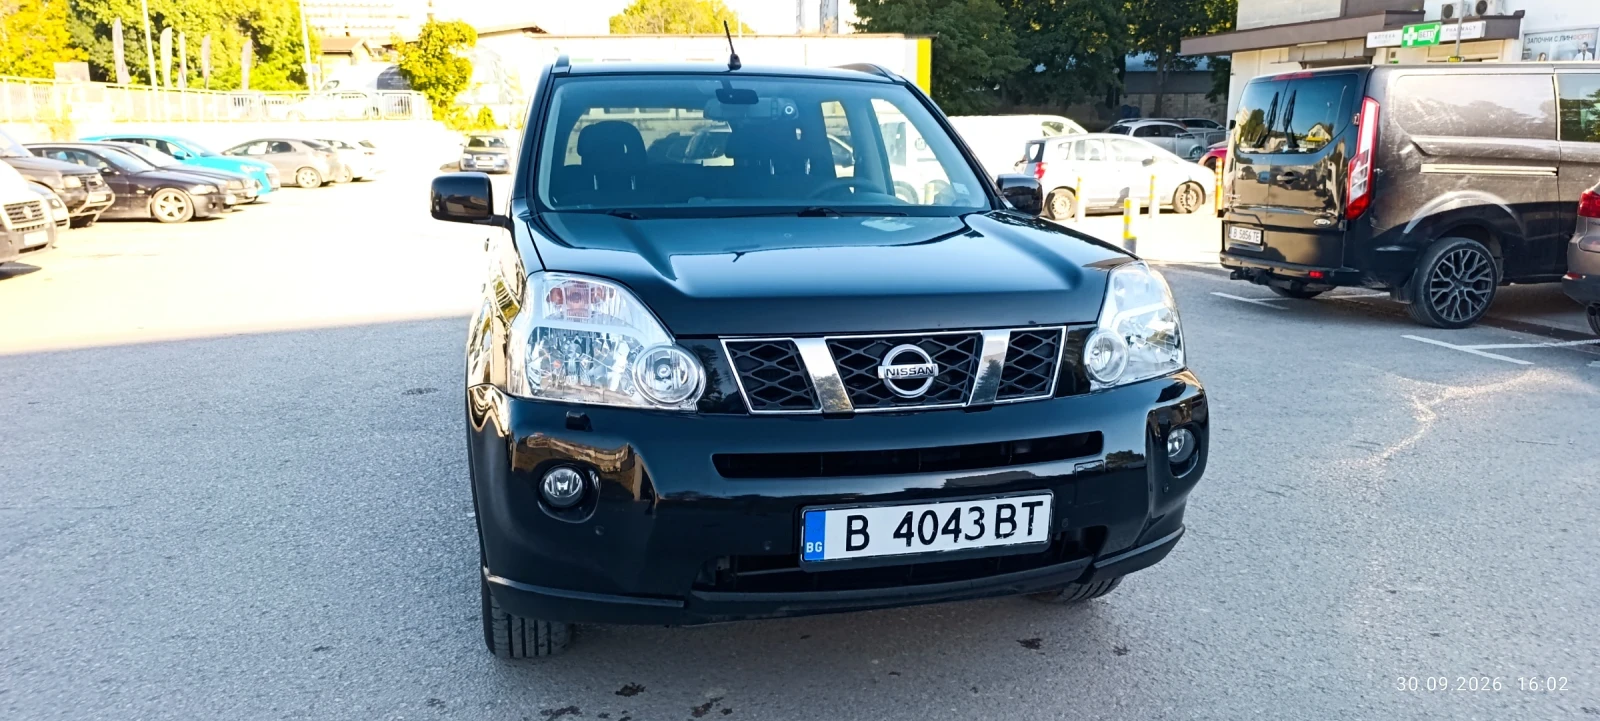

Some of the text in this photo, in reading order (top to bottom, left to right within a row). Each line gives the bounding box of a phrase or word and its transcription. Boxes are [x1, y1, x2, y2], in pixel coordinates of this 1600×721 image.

[1527, 36, 1553, 44] ЗАПОЧНИ
[1253, 231, 1260, 242] TE
[886, 366, 934, 377] NISSAN
[845, 514, 870, 552] B
[806, 541, 823, 553] BG
